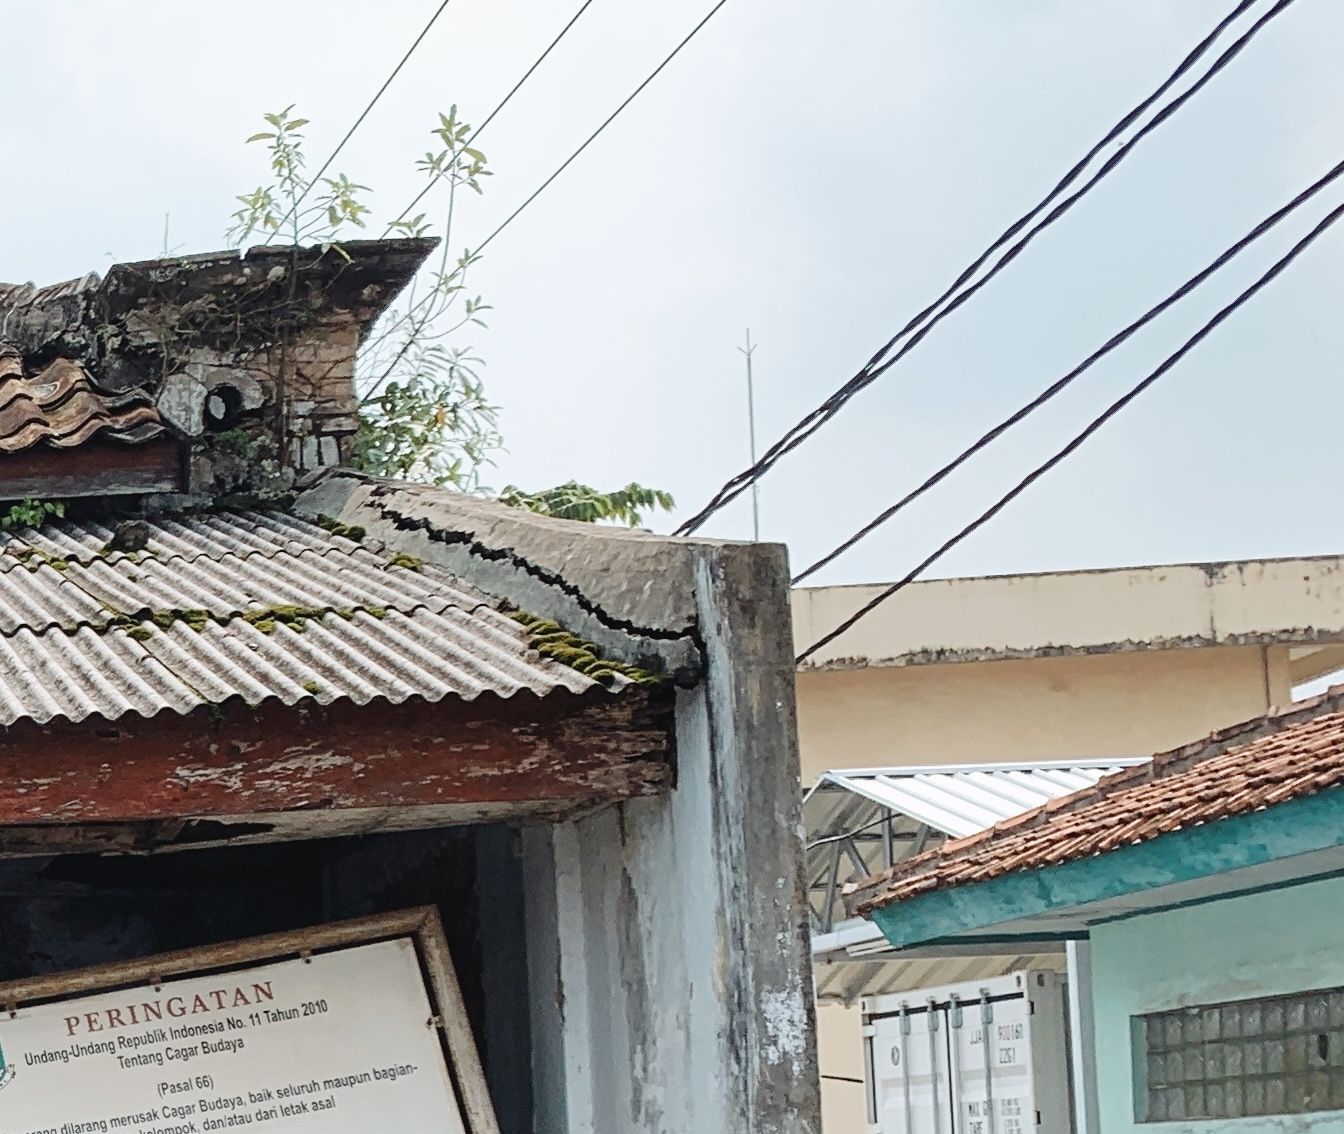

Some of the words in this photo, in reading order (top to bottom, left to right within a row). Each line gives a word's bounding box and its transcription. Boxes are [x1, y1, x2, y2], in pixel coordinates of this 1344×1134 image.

[23, 1040, 117, 1066] Undang-Undang
[116, 1027, 169, 1050] Republik
[168, 1021, 226, 1040] Indonesia
[225, 1015, 248, 1031] No.
[248, 1011, 262, 1027] 11
[262, 1007, 300, 1024] Tahun
[300, 998, 329, 1017] 2010
[63, 980, 274, 1037] PERINGATAN
[115, 1051, 164, 1070] Tentang
[164, 1045, 199, 1062] Cagar
[199, 1037, 245, 1055] Budaya
[108, 1107, 161, 1129] merusak
[160, 1103, 196, 1120] Cagar
[197, 1095, 248, 1113] Budaya,
[247, 1087, 275, 1104] baik
[275, 1079, 321, 1099] seluruh
[321, 1071, 372, 1091] maupun
[371, 1063, 418, 1082] bagian-
[156, 1077, 194, 1099] (Pasal
[194, 1074, 214, 1090] 66)
[201, 1112, 253, 1132] dan/atau
[254, 1105, 279, 1122] dari
[278, 1100, 310, 1118] letak
[310, 1094, 336, 1112] asal
